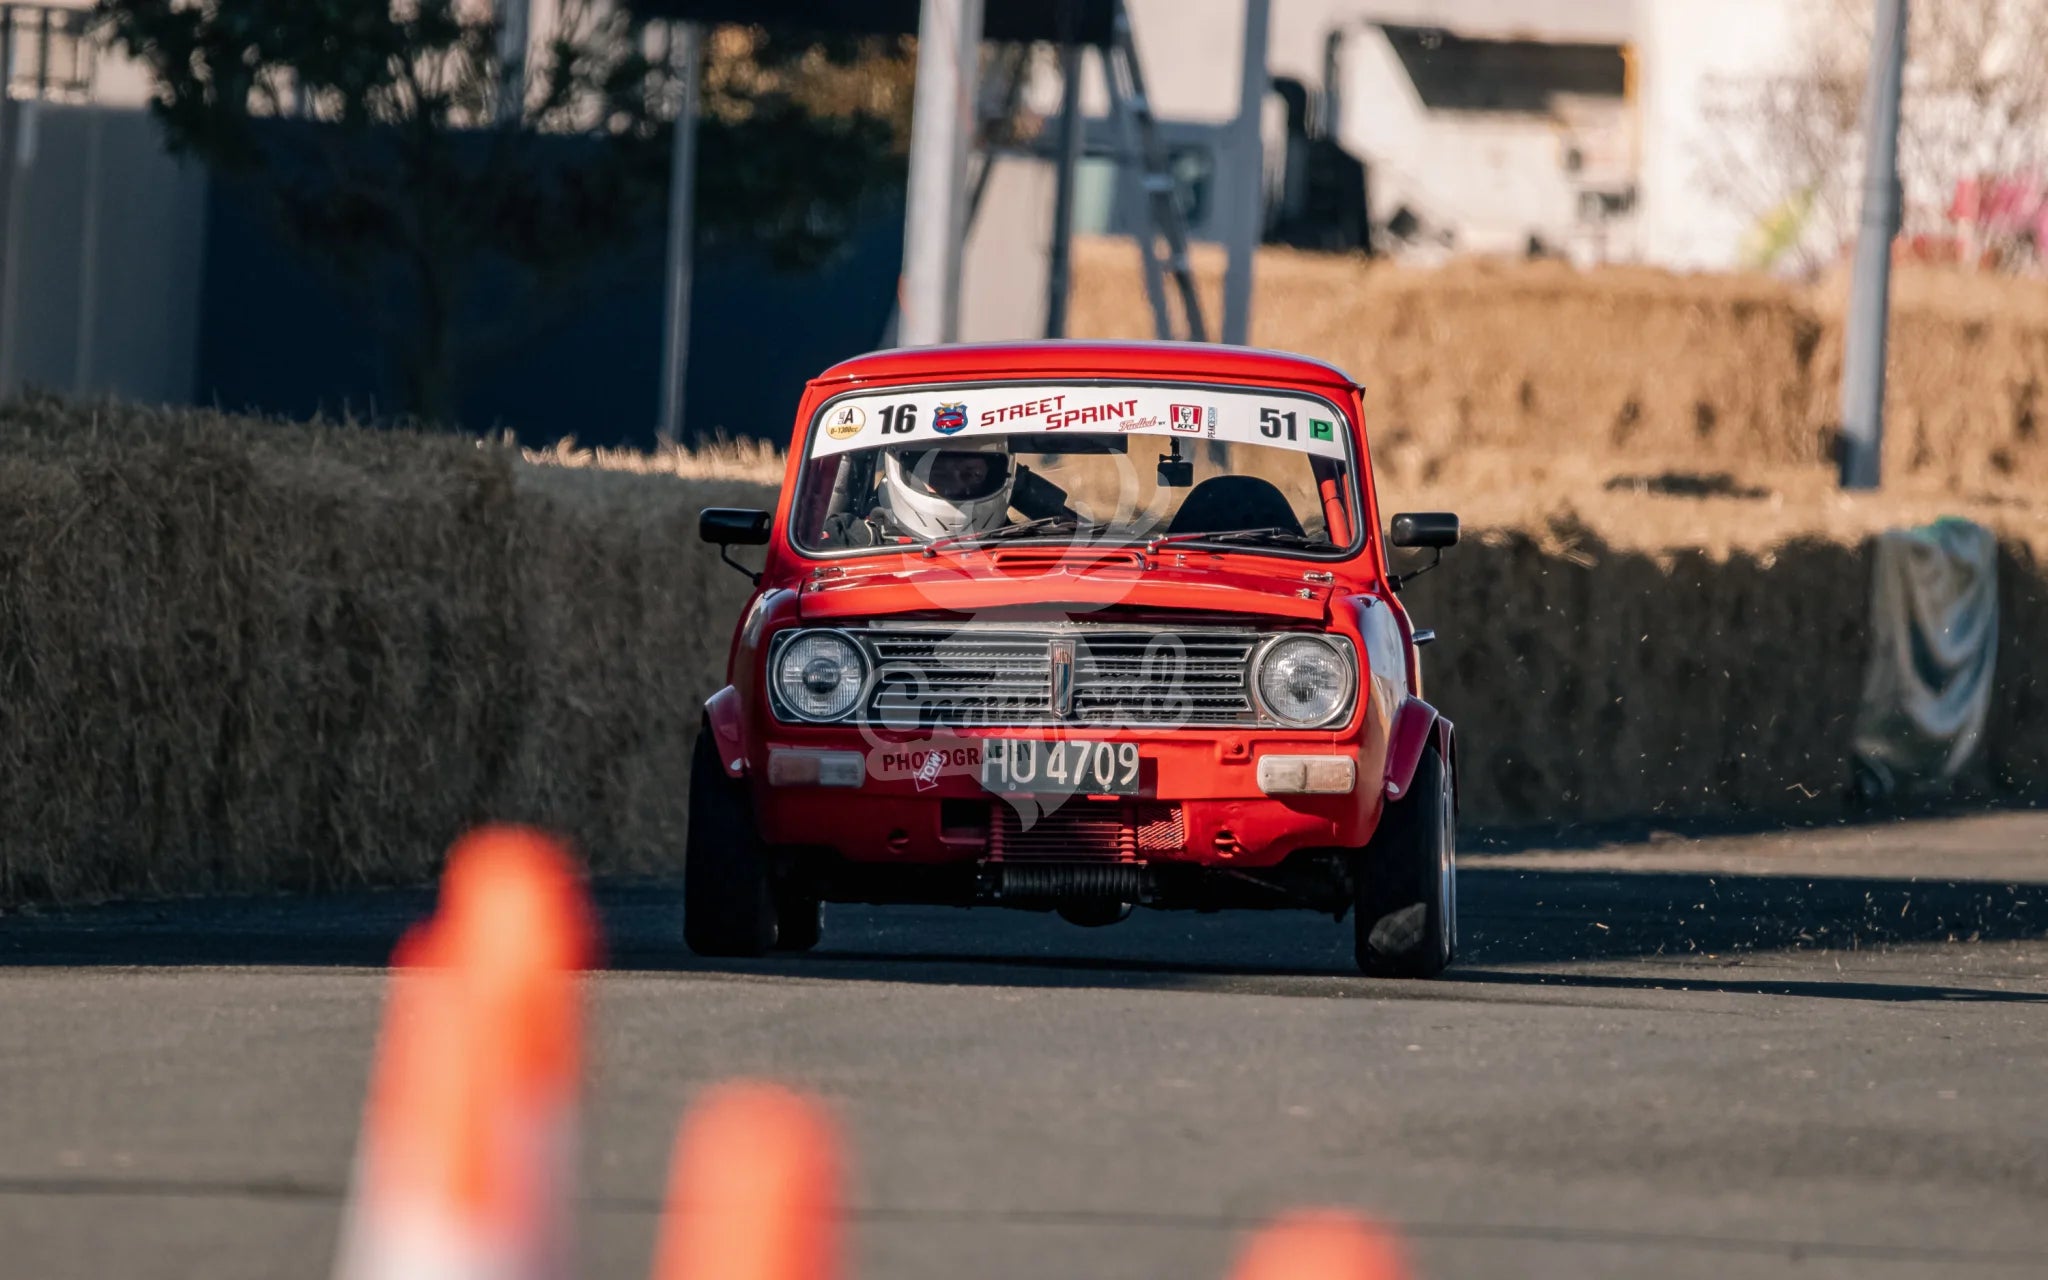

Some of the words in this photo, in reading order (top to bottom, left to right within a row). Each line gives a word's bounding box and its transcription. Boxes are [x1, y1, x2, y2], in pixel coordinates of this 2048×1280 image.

[843, 408, 854, 425] A
[877, 403, 918, 435] 16
[980, 394, 1066, 427] STREET
[1045, 399, 1138, 431] SPRINT
[1259, 407, 1297, 441] 51
[1313, 420, 1330, 439] P
[919, 751, 943, 782] TOW
[982, 738, 1036, 784] HU
[1046, 740, 1140, 786] 4709
